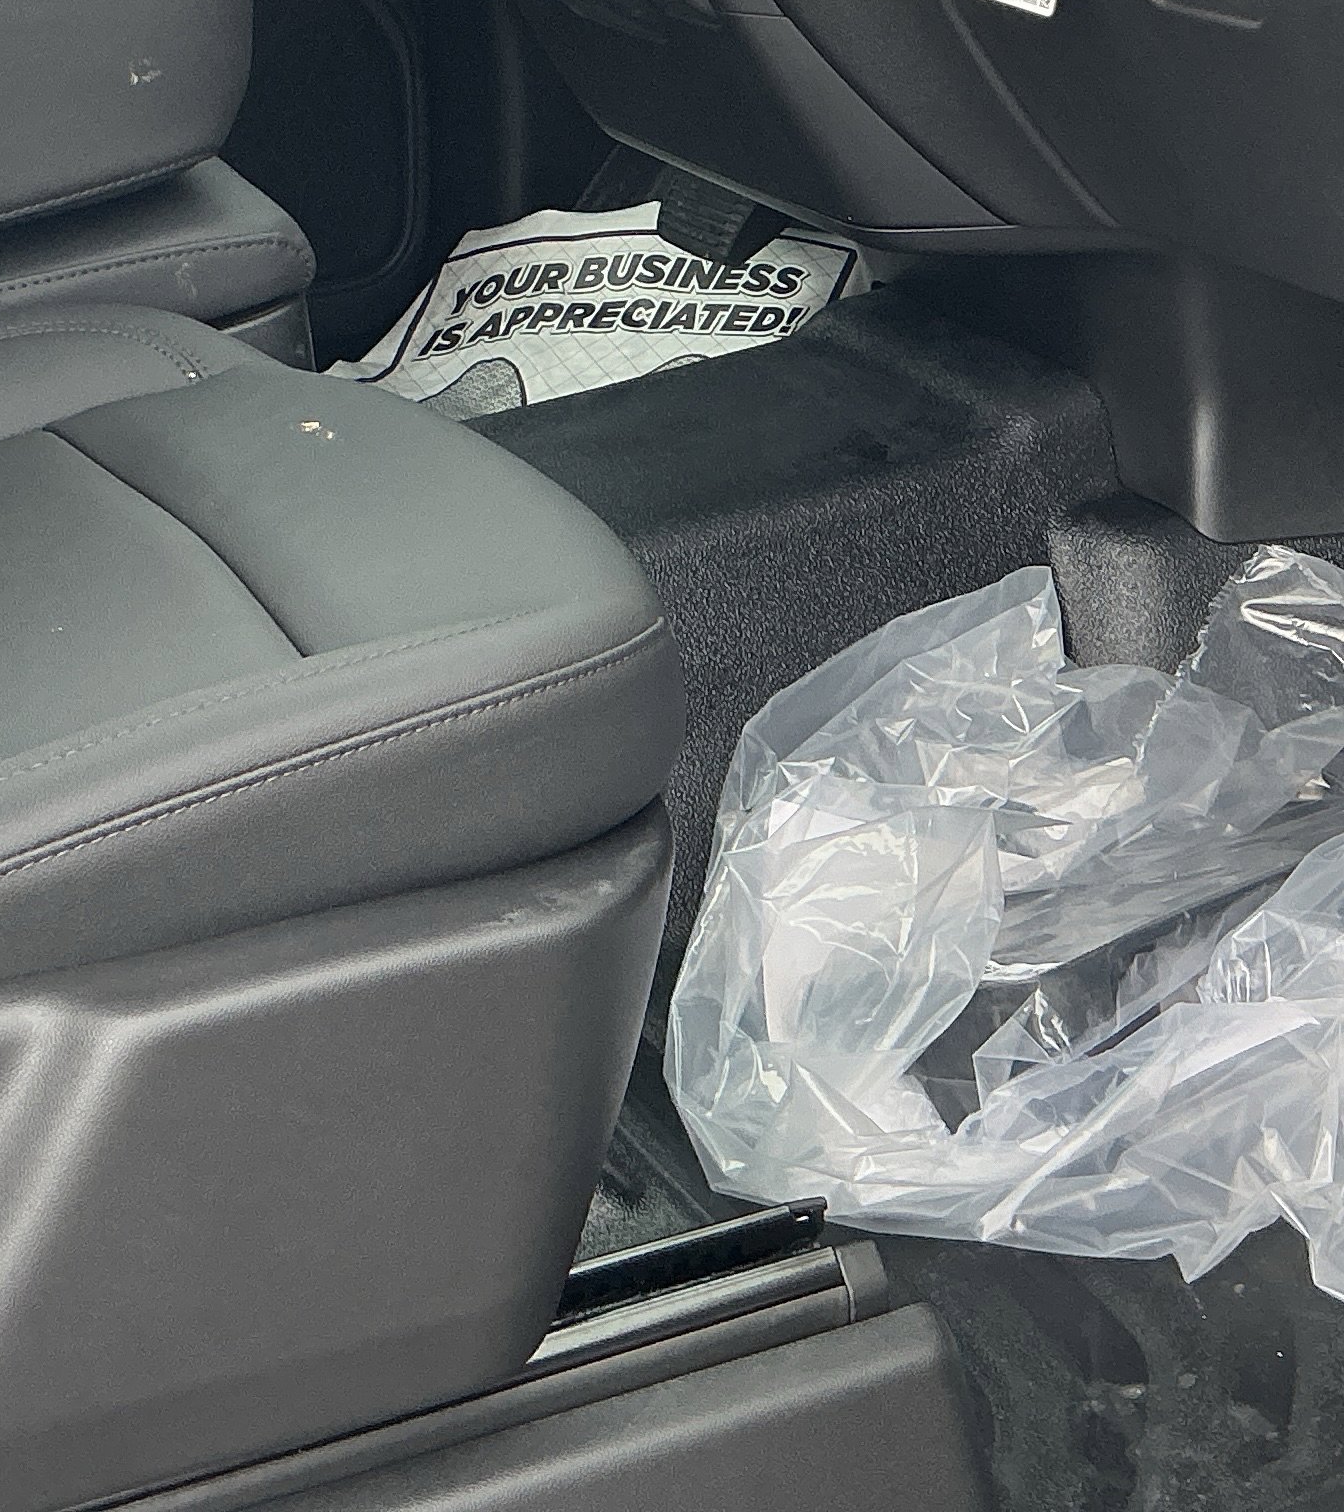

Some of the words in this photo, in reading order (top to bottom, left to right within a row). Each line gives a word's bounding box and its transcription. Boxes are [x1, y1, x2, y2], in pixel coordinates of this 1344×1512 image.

[452, 262, 571, 315] YOUR
[574, 253, 807, 297] BUSINESS
[417, 324, 467, 361] IS
[470, 297, 810, 338] APPRECIATED!
